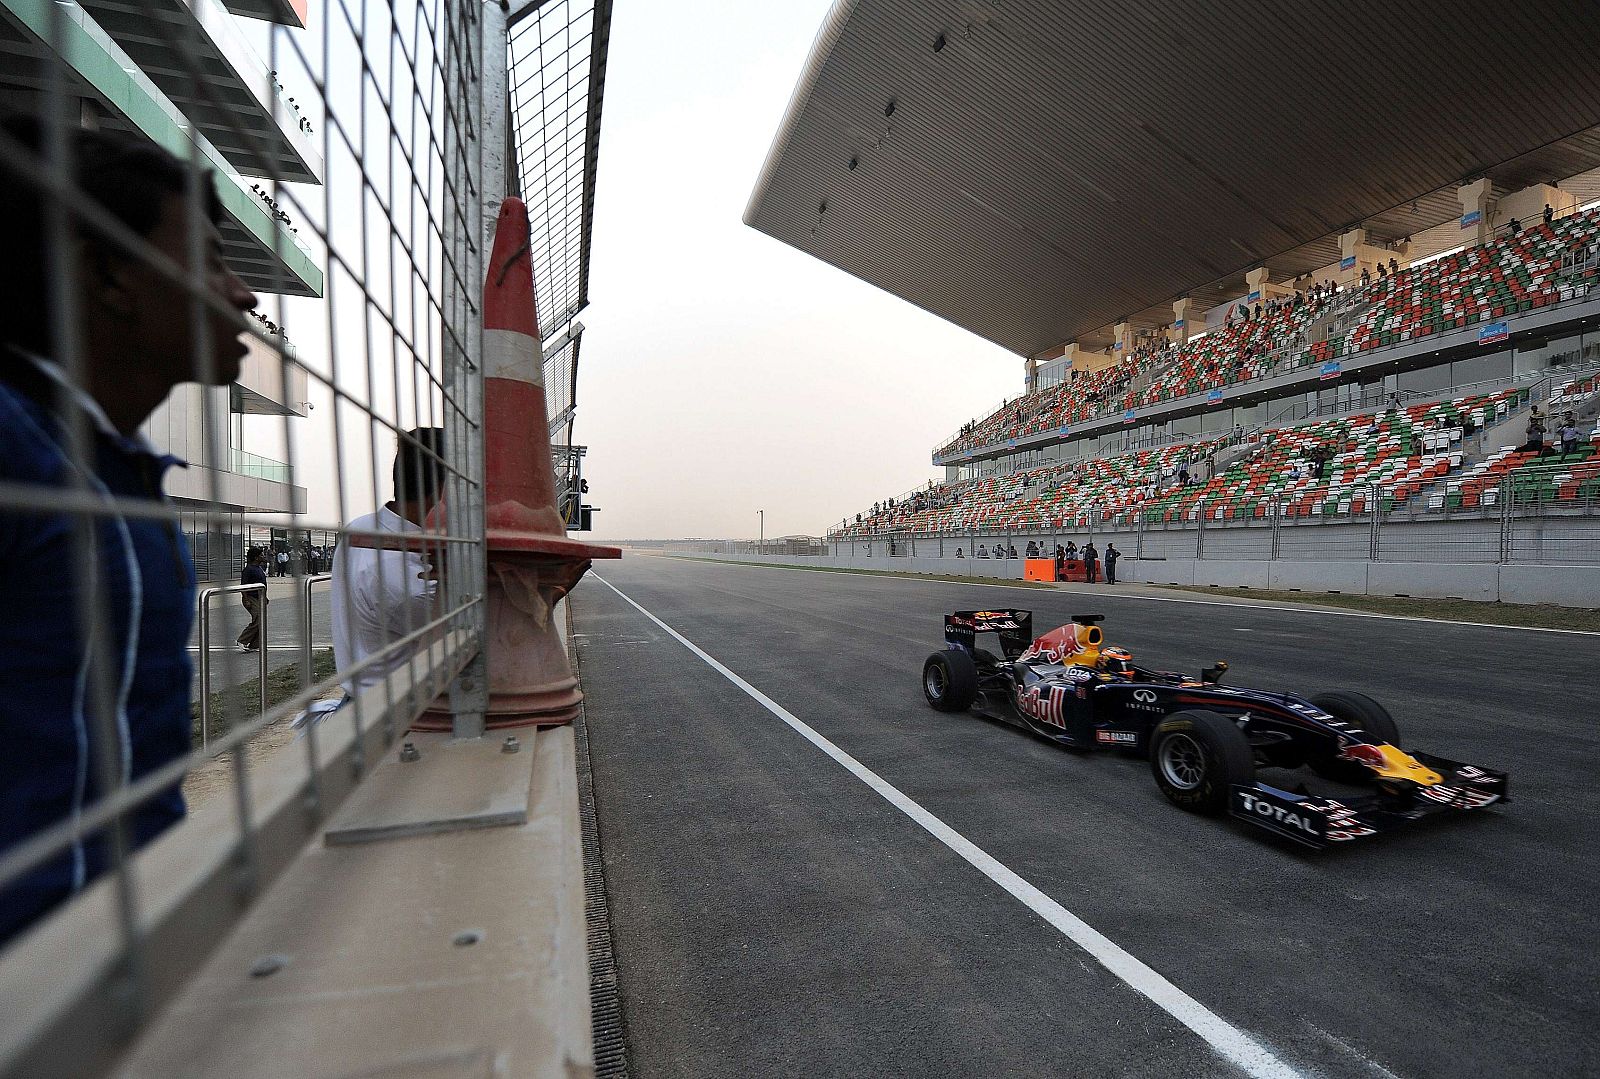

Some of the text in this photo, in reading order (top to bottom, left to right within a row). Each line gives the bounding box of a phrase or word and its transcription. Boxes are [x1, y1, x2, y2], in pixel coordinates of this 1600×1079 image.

[1030, 686, 1067, 730] Bull
[1126, 702, 1165, 714] INFINITI
[1238, 791, 1320, 836] TOTAL
